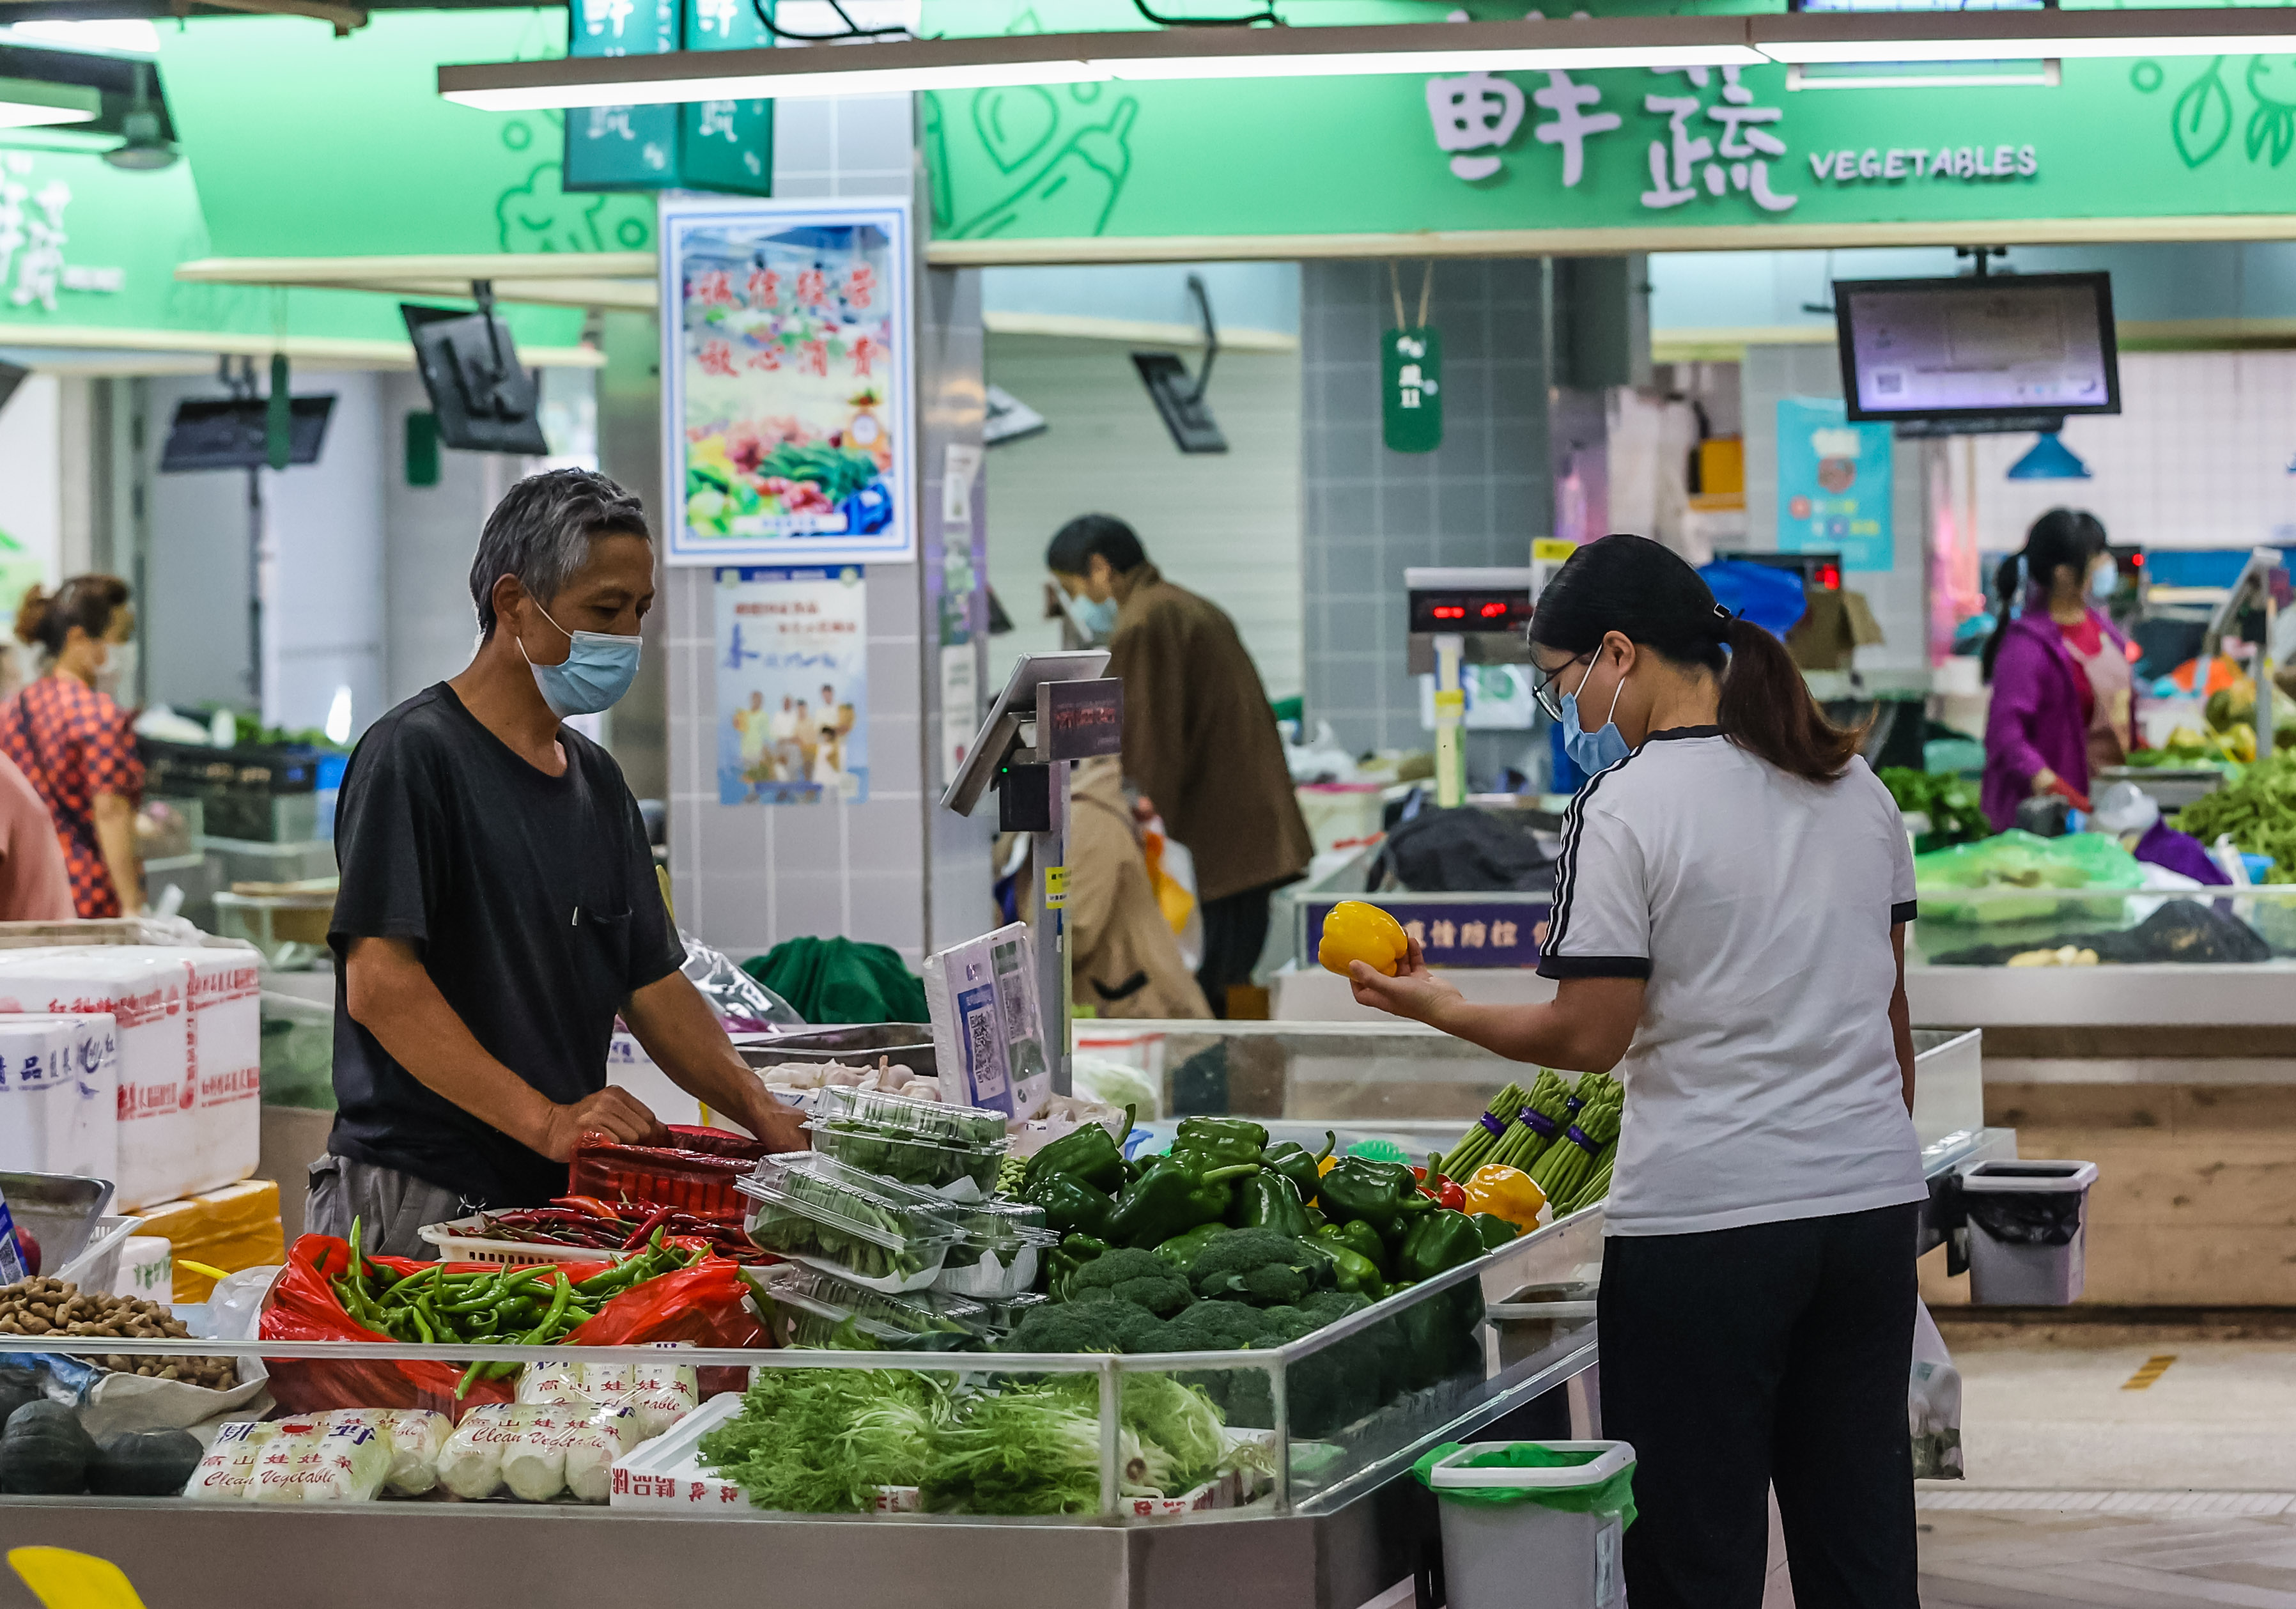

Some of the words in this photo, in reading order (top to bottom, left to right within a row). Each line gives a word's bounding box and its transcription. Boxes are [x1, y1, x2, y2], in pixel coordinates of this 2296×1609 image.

[1425, 10, 1797, 210] 鲜蔬
[1809, 144, 2038, 180] VEGETABLES
[467, 1418, 621, 1440] 高山娃娃菜
[472, 1427, 522, 1443] Clean
[202, 1452, 353, 1474] 高山娃娃菜
[203, 1472, 255, 1487] Clean
[260, 1468, 336, 1488] Vegetable
